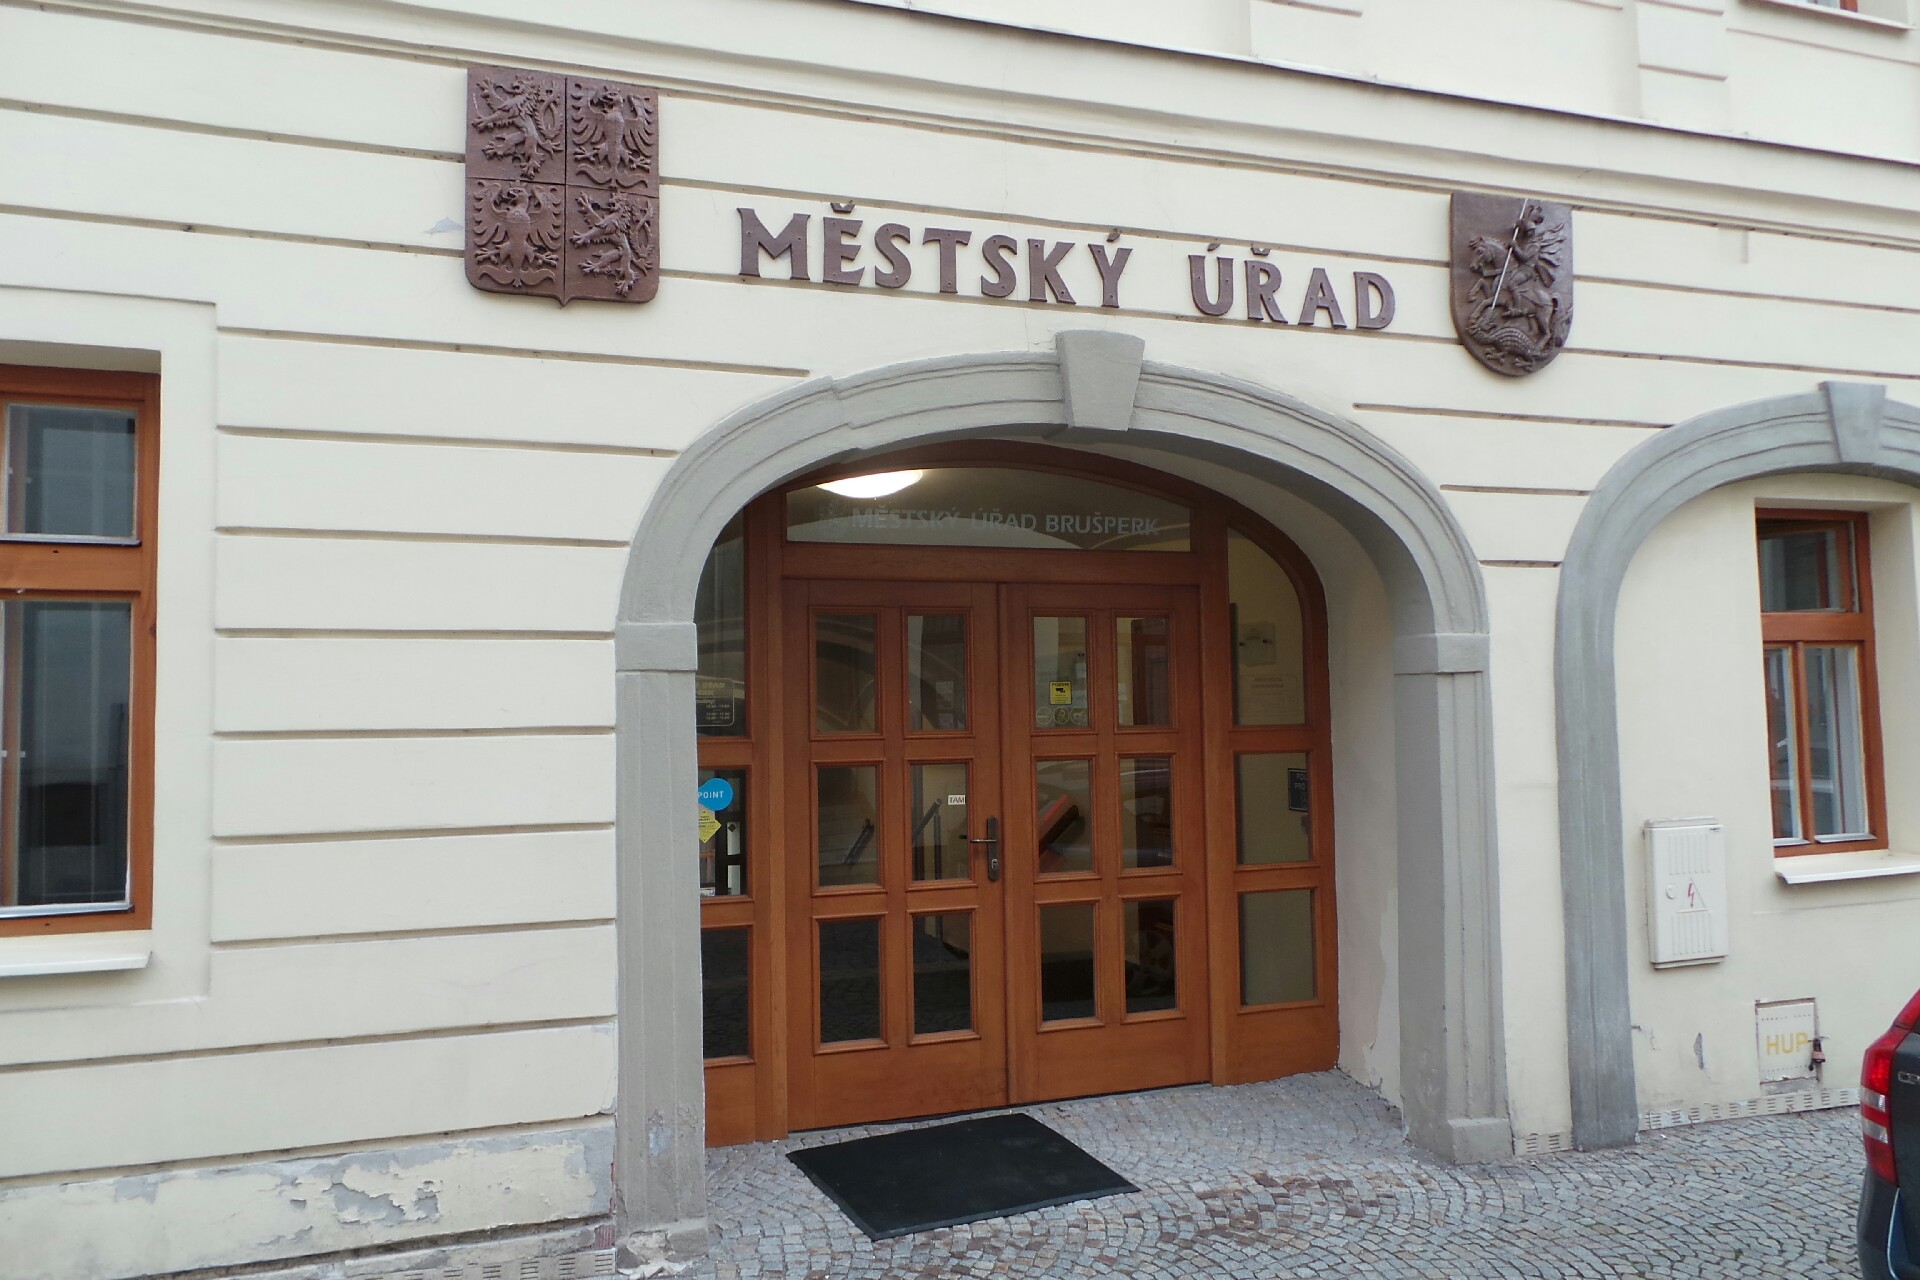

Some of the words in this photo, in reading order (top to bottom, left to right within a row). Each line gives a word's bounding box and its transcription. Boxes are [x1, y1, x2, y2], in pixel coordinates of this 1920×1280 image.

[736, 201, 1133, 309] MĚSTSKÝ
[1187, 243, 1396, 330] ÚŘAD
[853, 506, 961, 530] MĚSTSKÝ
[970, 506, 1037, 533] ÚŘAD
[1046, 512, 1159, 536] BRUŠPERK
[1765, 1032, 1809, 1055] HUP
